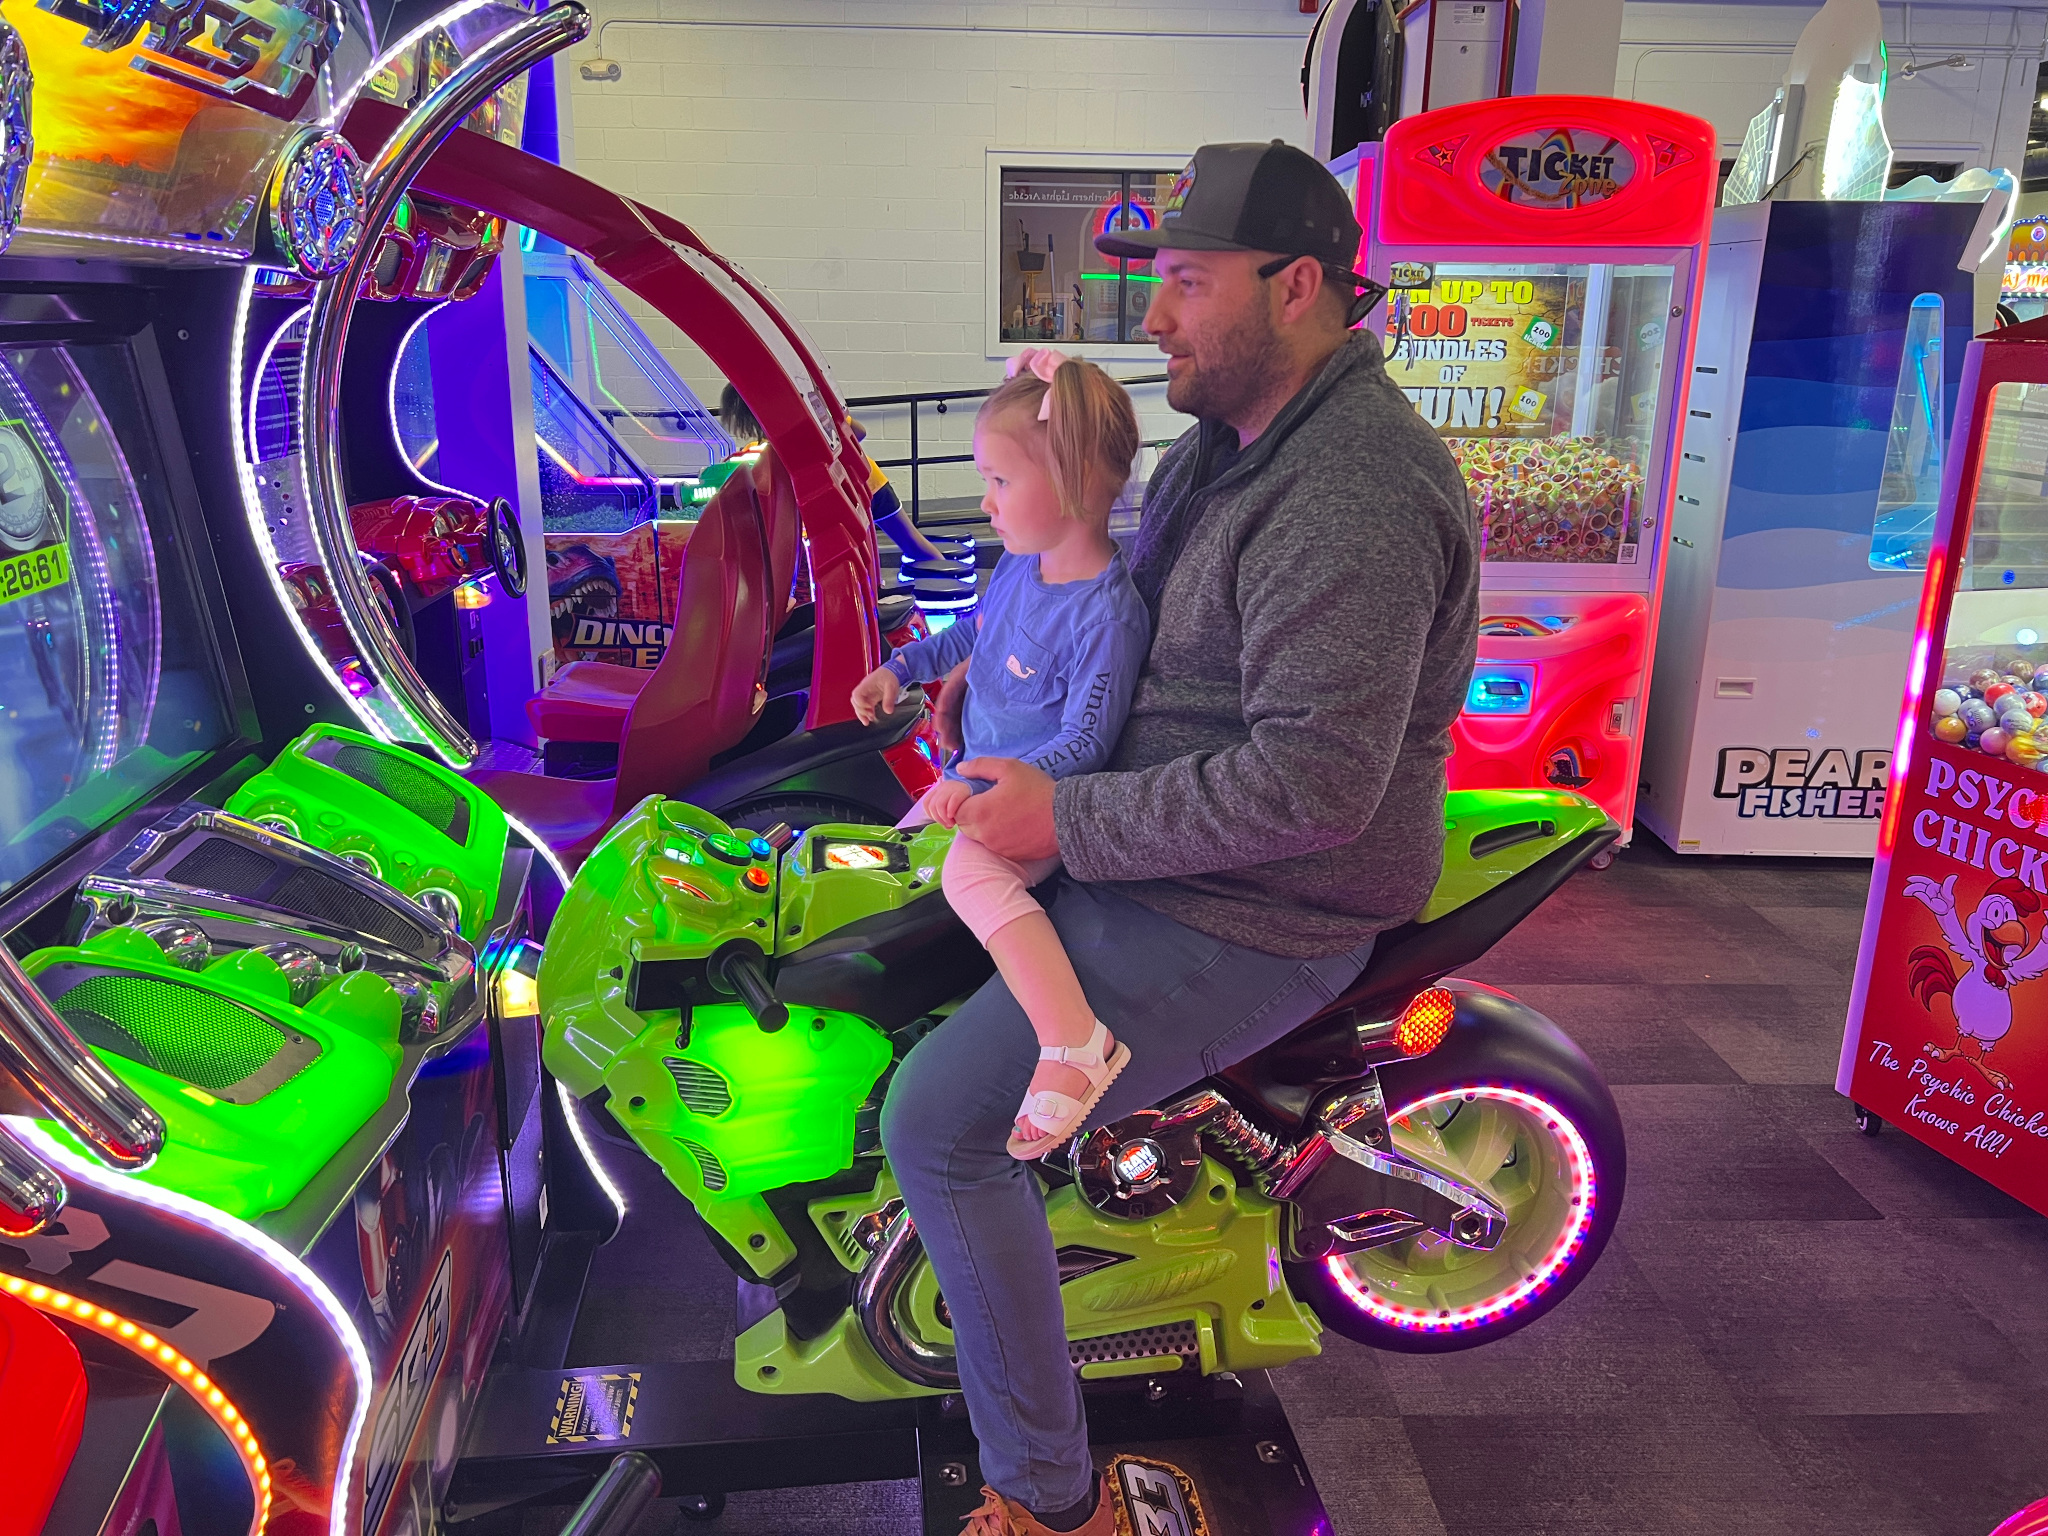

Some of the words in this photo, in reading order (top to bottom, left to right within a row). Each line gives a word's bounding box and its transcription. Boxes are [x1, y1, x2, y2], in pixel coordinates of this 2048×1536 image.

[1498, 145, 1615, 182] TICKET
[1558, 169, 1617, 196] Zone
[1440, 280, 1484, 304] UP
[1490, 280, 1534, 304] TO
[1470, 317, 1514, 327] TICKETS
[1532, 325, 1550, 339] 200
[1393, 339, 1507, 362] BUNDLES
[1439, 365, 1466, 384] OF
[1518, 394, 1538, 409] 100
[1924, 757, 2048, 838] PSYC
[1869, 1040, 1900, 1071] The
[1907, 1057, 1975, 1105] Psychic
[1983, 1092, 2048, 1141] Chicke
[1903, 1093, 1960, 1136] Knows
[1962, 1123, 2013, 1159] All!
[1118, 1144, 1153, 1175] RAW
[558, 1381, 585, 1437] WARNING!
